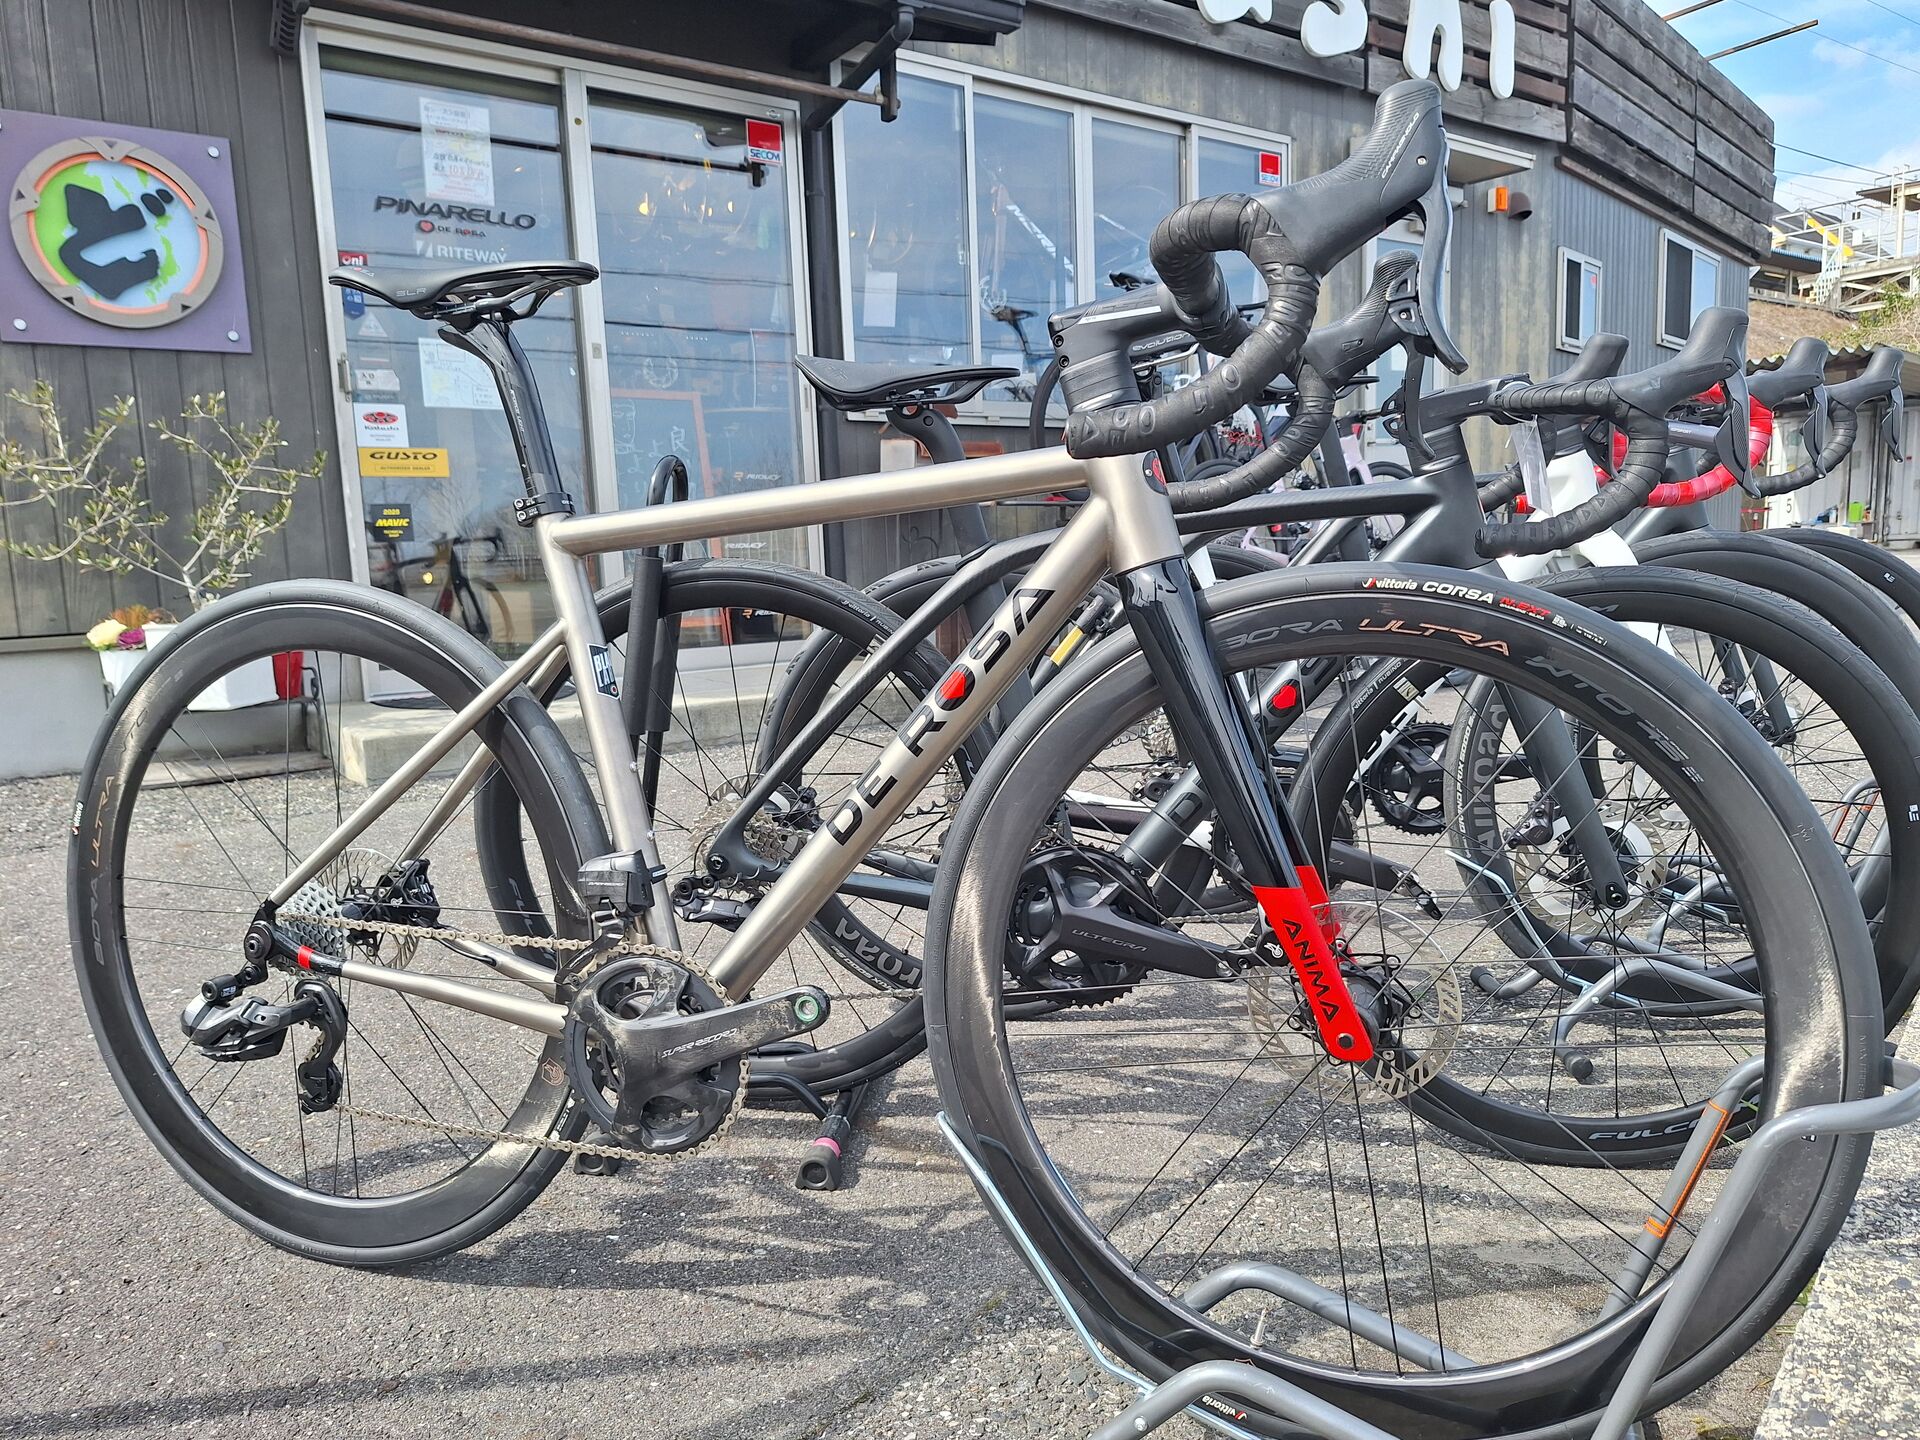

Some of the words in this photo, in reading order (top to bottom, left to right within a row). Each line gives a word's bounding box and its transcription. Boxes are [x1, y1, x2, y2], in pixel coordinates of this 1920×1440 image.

[750, 148, 780, 161] SECOM
[1381, 112, 1420, 179] CAMPAGNOLO
[437, 225, 451, 233] DE
[456, 228, 487, 238] ROSA
[437, 245, 508, 264] RITEWAY
[396, 287, 427, 297] SLR
[369, 451, 438, 461] GUSTO
[375, 518, 410, 528] MAVIC
[1375, 578, 1418, 590] vittoria
[1422, 581, 1494, 604] CORSA
[848, 603, 872, 618] vittoria
[1358, 618, 1510, 656] ULTRA
[826, 758, 899, 847] DE
[898, 588, 1057, 758] ROSA
[1456, 762, 1466, 796] PRIX
[1461, 727, 1472, 761] 5000
[1477, 703, 1508, 859] Allroad
[73, 801, 84, 828] vittoria
[91, 775, 116, 869] ULTRA
[90, 877, 105, 967] BORA
[834, 917, 920, 985] road
[1072, 929, 1148, 952] ULTEGRA
[1282, 918, 1341, 1023] ANIMA
[661, 1042, 695, 1059] SUPER
[695, 1027, 738, 1046] RECORD
[1201, 1395, 1237, 1418] vittoria
